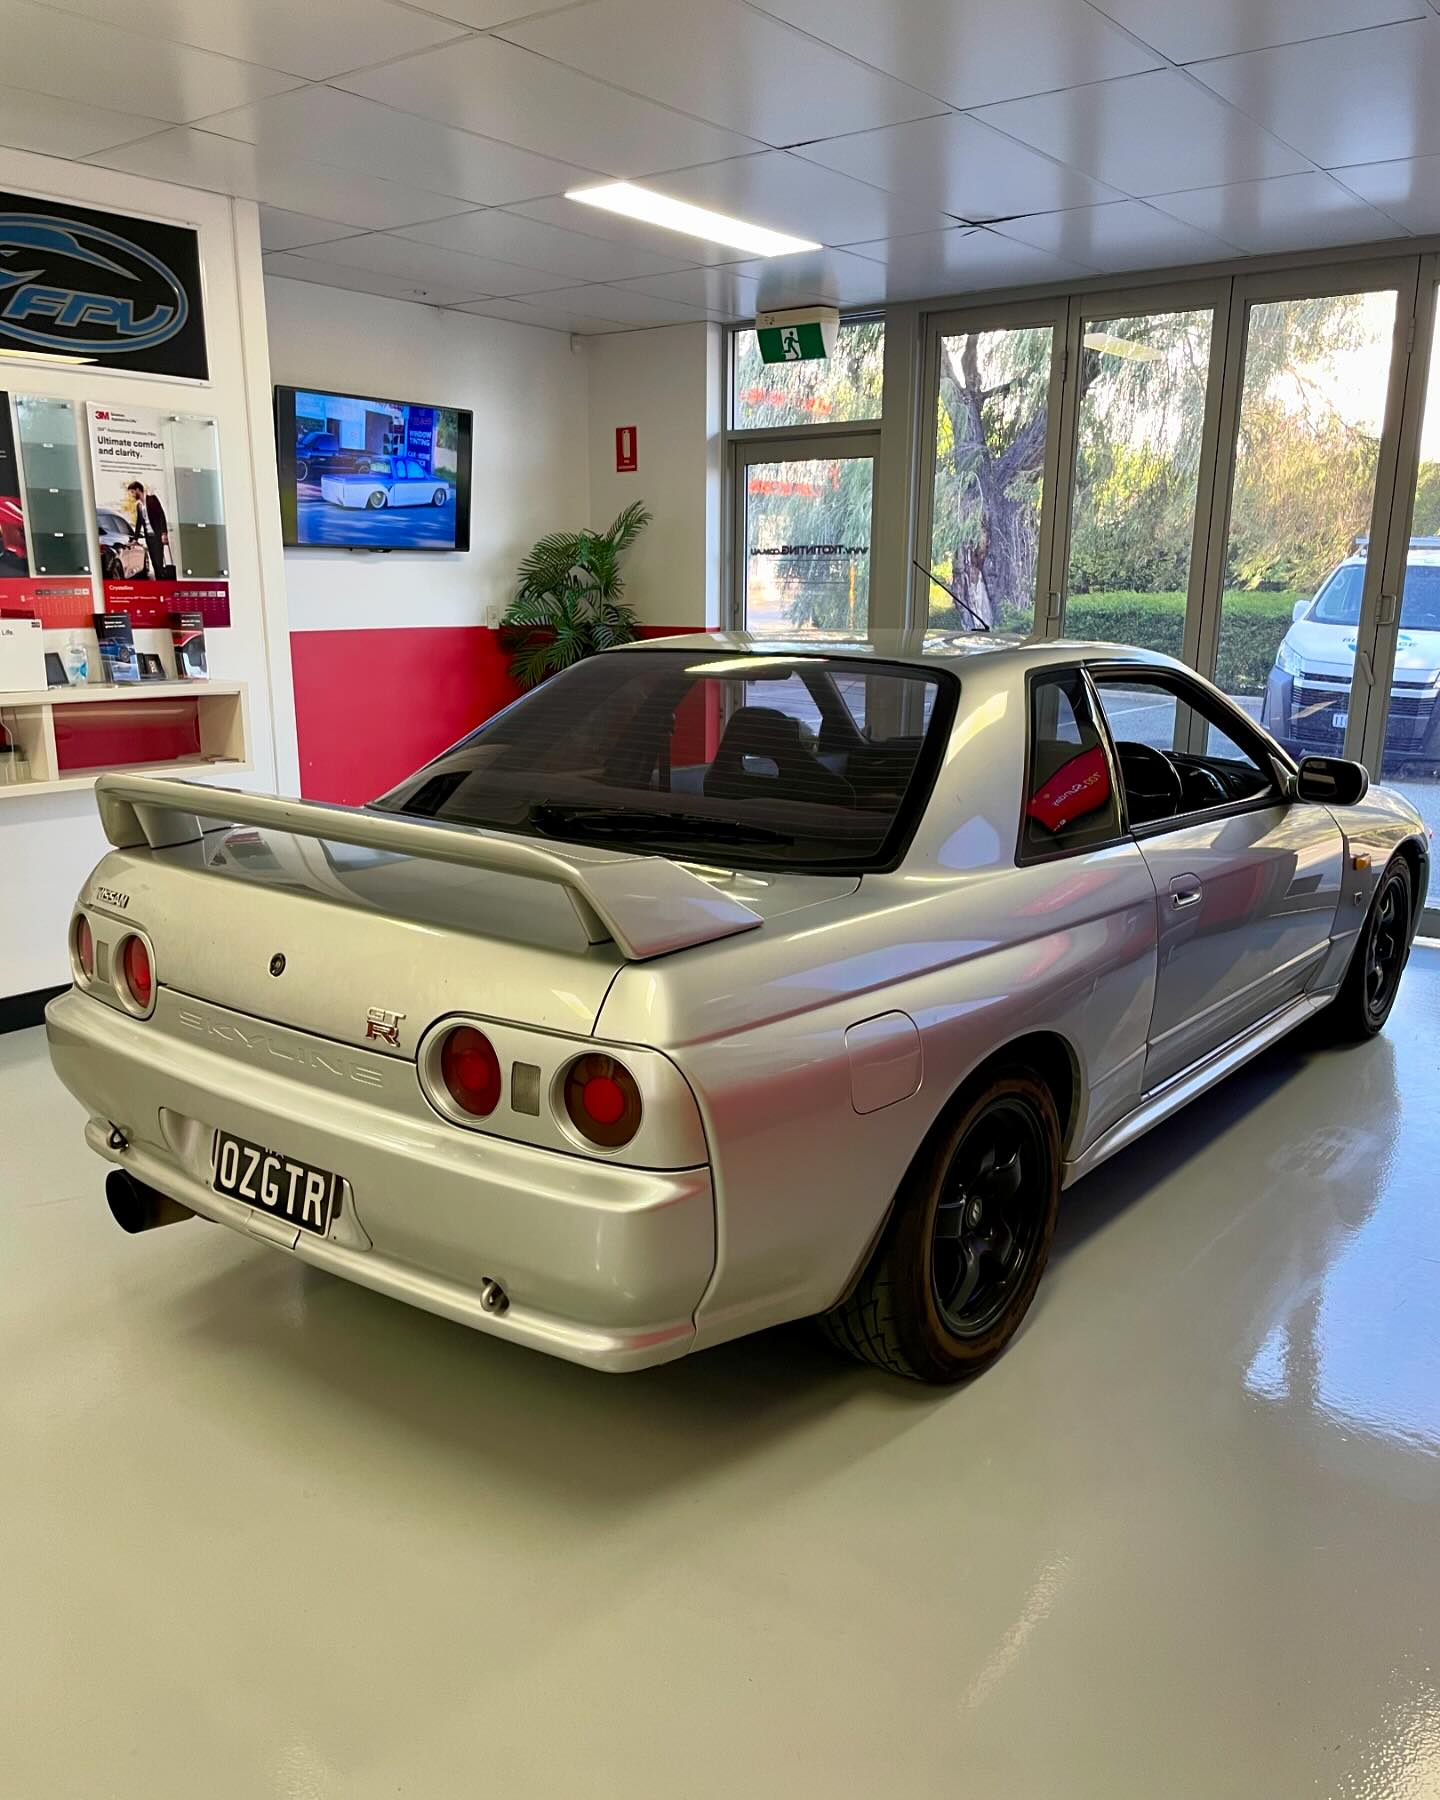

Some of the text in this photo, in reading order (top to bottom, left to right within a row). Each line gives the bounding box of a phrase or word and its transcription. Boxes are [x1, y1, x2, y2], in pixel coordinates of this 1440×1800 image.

[95, 410, 110, 421] 3M
[97, 435, 165, 450] Ultimate comfort
[98, 447, 143, 459] and clarity.
[97, 887, 130, 909] NISSAN
[179, 1009, 384, 1088] SKYLINE
[219, 1140, 325, 1227] OZGTR
